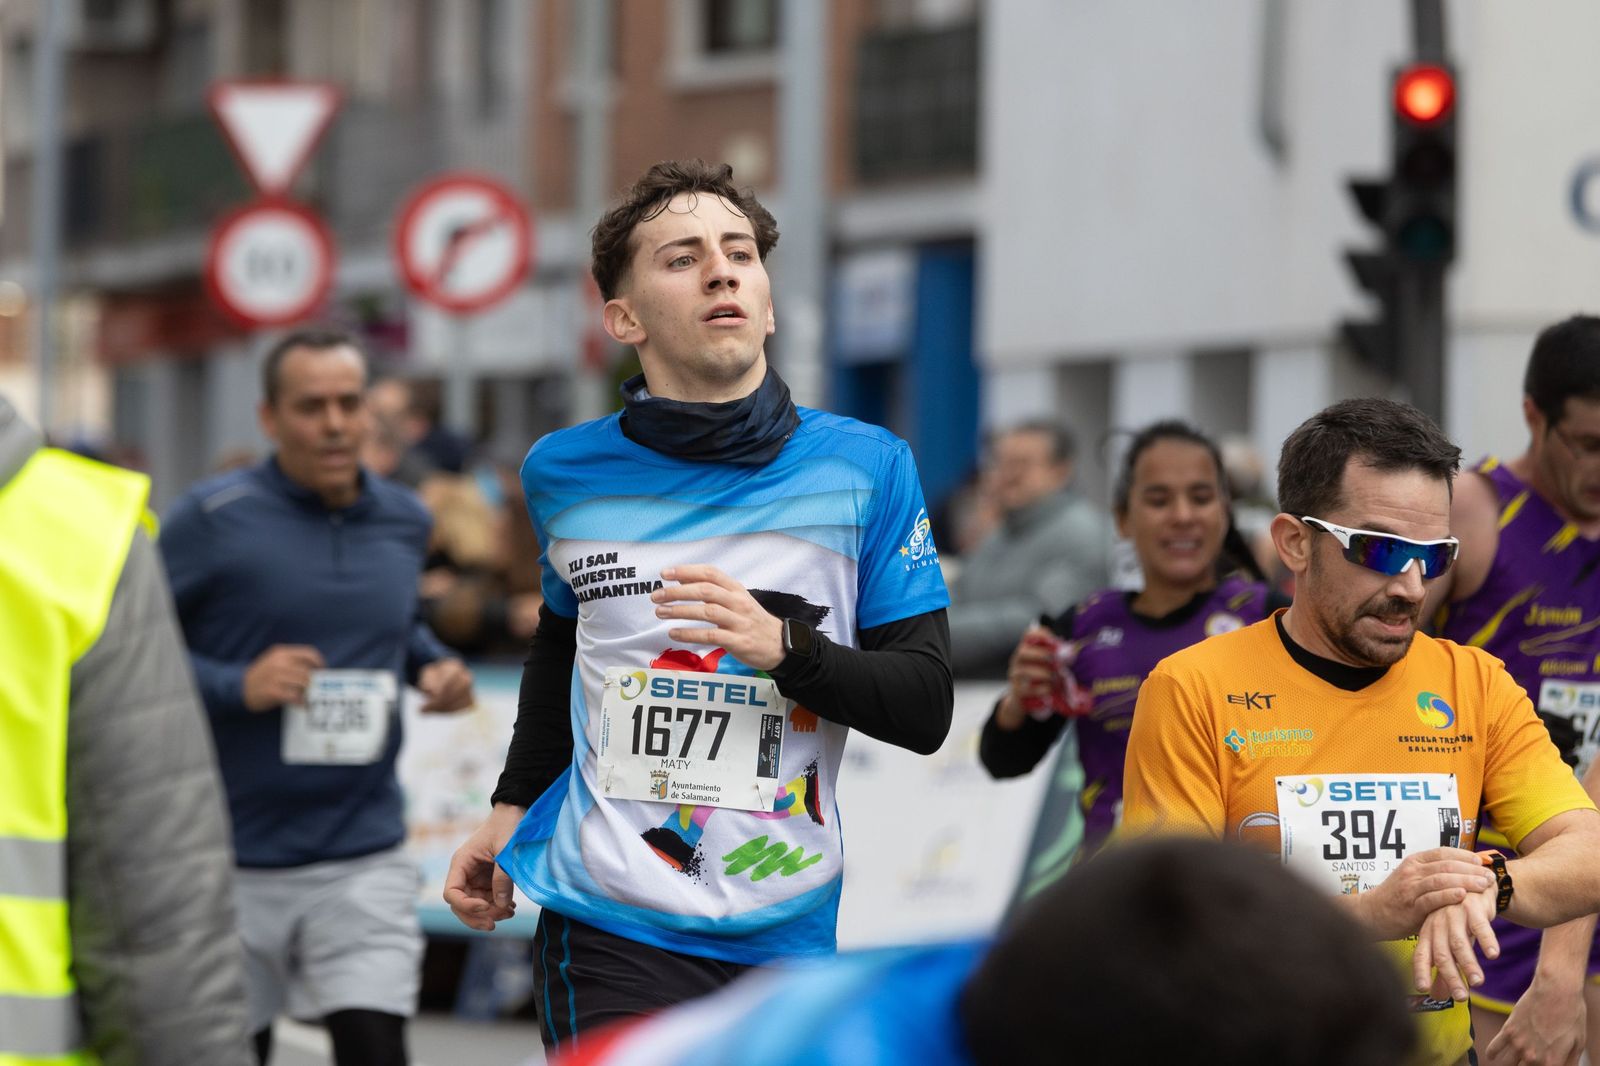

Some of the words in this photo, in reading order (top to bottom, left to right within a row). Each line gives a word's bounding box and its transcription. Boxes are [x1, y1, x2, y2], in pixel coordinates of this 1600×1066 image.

[568, 558, 584, 574] XLI
[586, 552, 618, 568] SAN
[571, 566, 636, 590] SILVESTRE
[576, 580, 664, 604] ALMANTINA
[651, 677, 768, 708] SETEL
[1227, 691, 1277, 710] EKT
[632, 704, 731, 761] 1677
[1251, 728, 1313, 743] turismo
[1398, 735, 1437, 743] ESCUELA
[661, 758, 691, 770] MATY
[671, 780, 721, 793] Ayuntamiento
[1329, 781, 1441, 802] SETEL
[670, 791, 680, 800] de
[681, 791, 720, 803] Salamanca
[1321, 809, 1406, 860] 394
[1332, 862, 1376, 872] SANTOS
